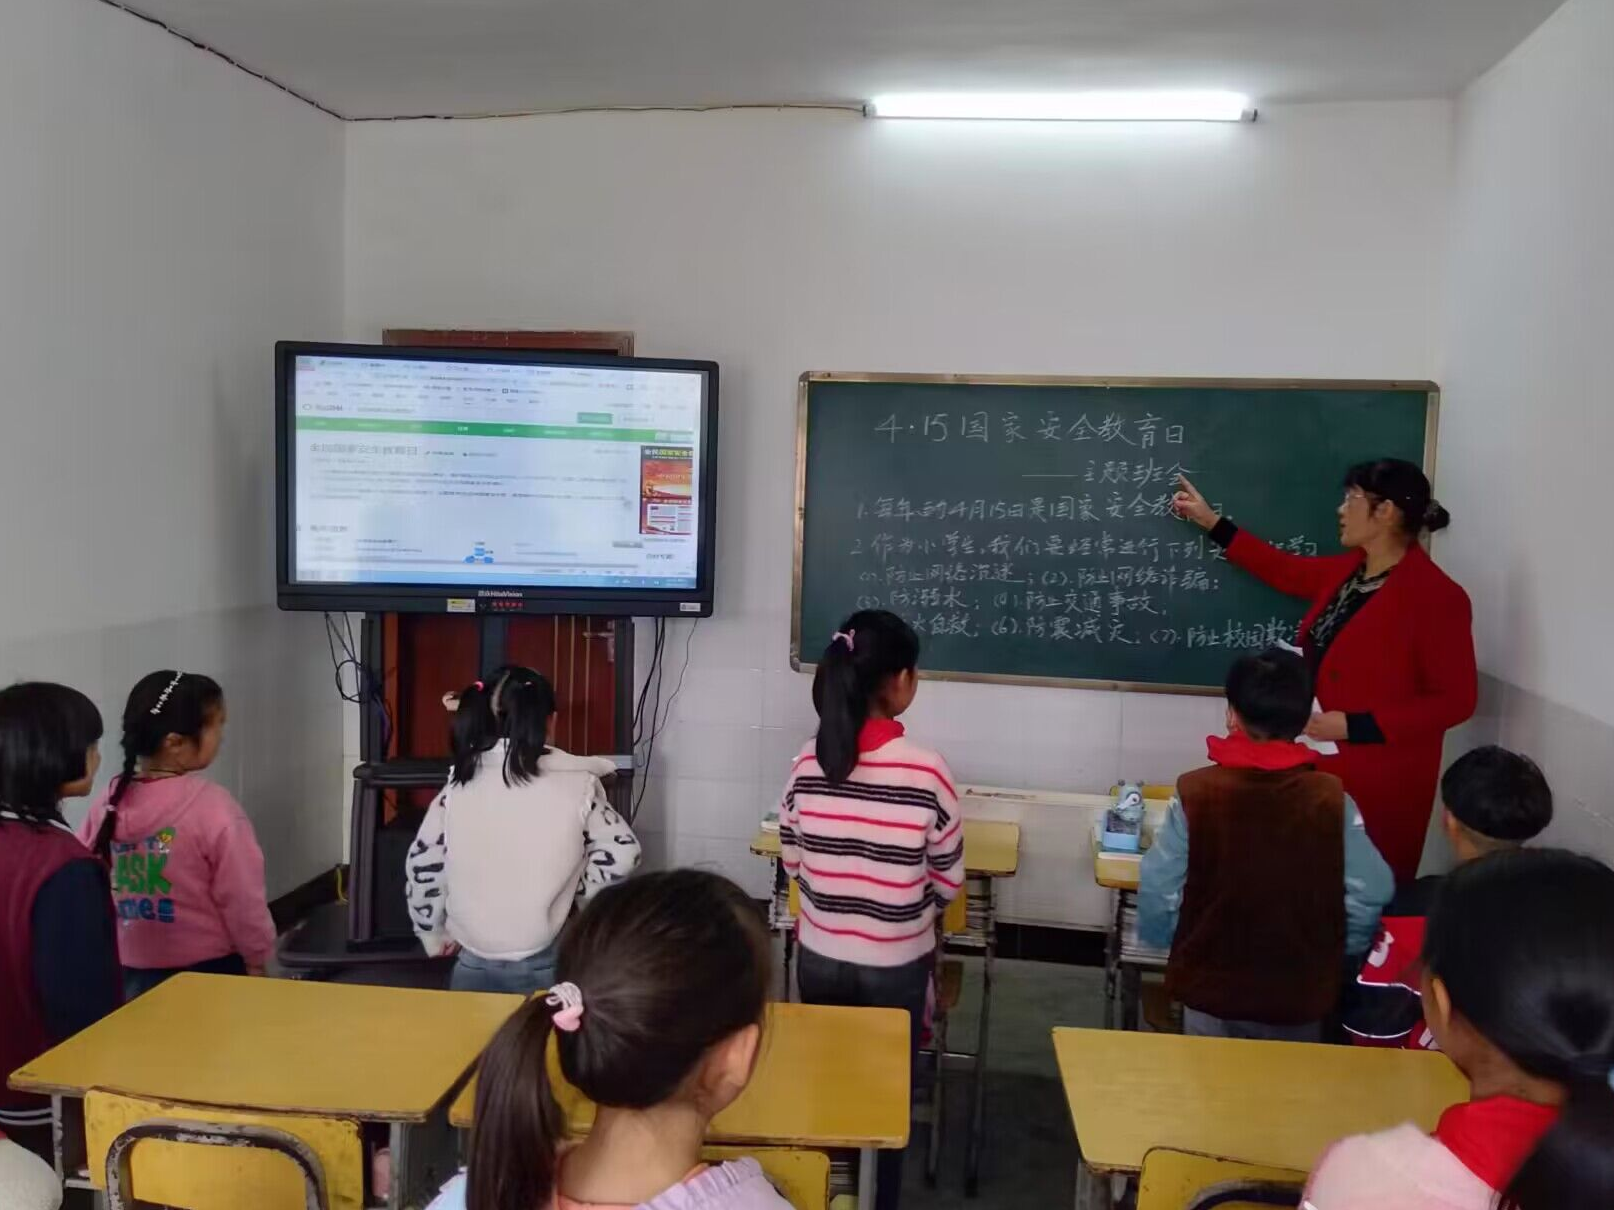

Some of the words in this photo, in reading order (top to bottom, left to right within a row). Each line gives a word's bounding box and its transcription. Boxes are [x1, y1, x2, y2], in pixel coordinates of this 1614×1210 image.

[873, 410, 1185, 449] 4·15国家安全教育日
